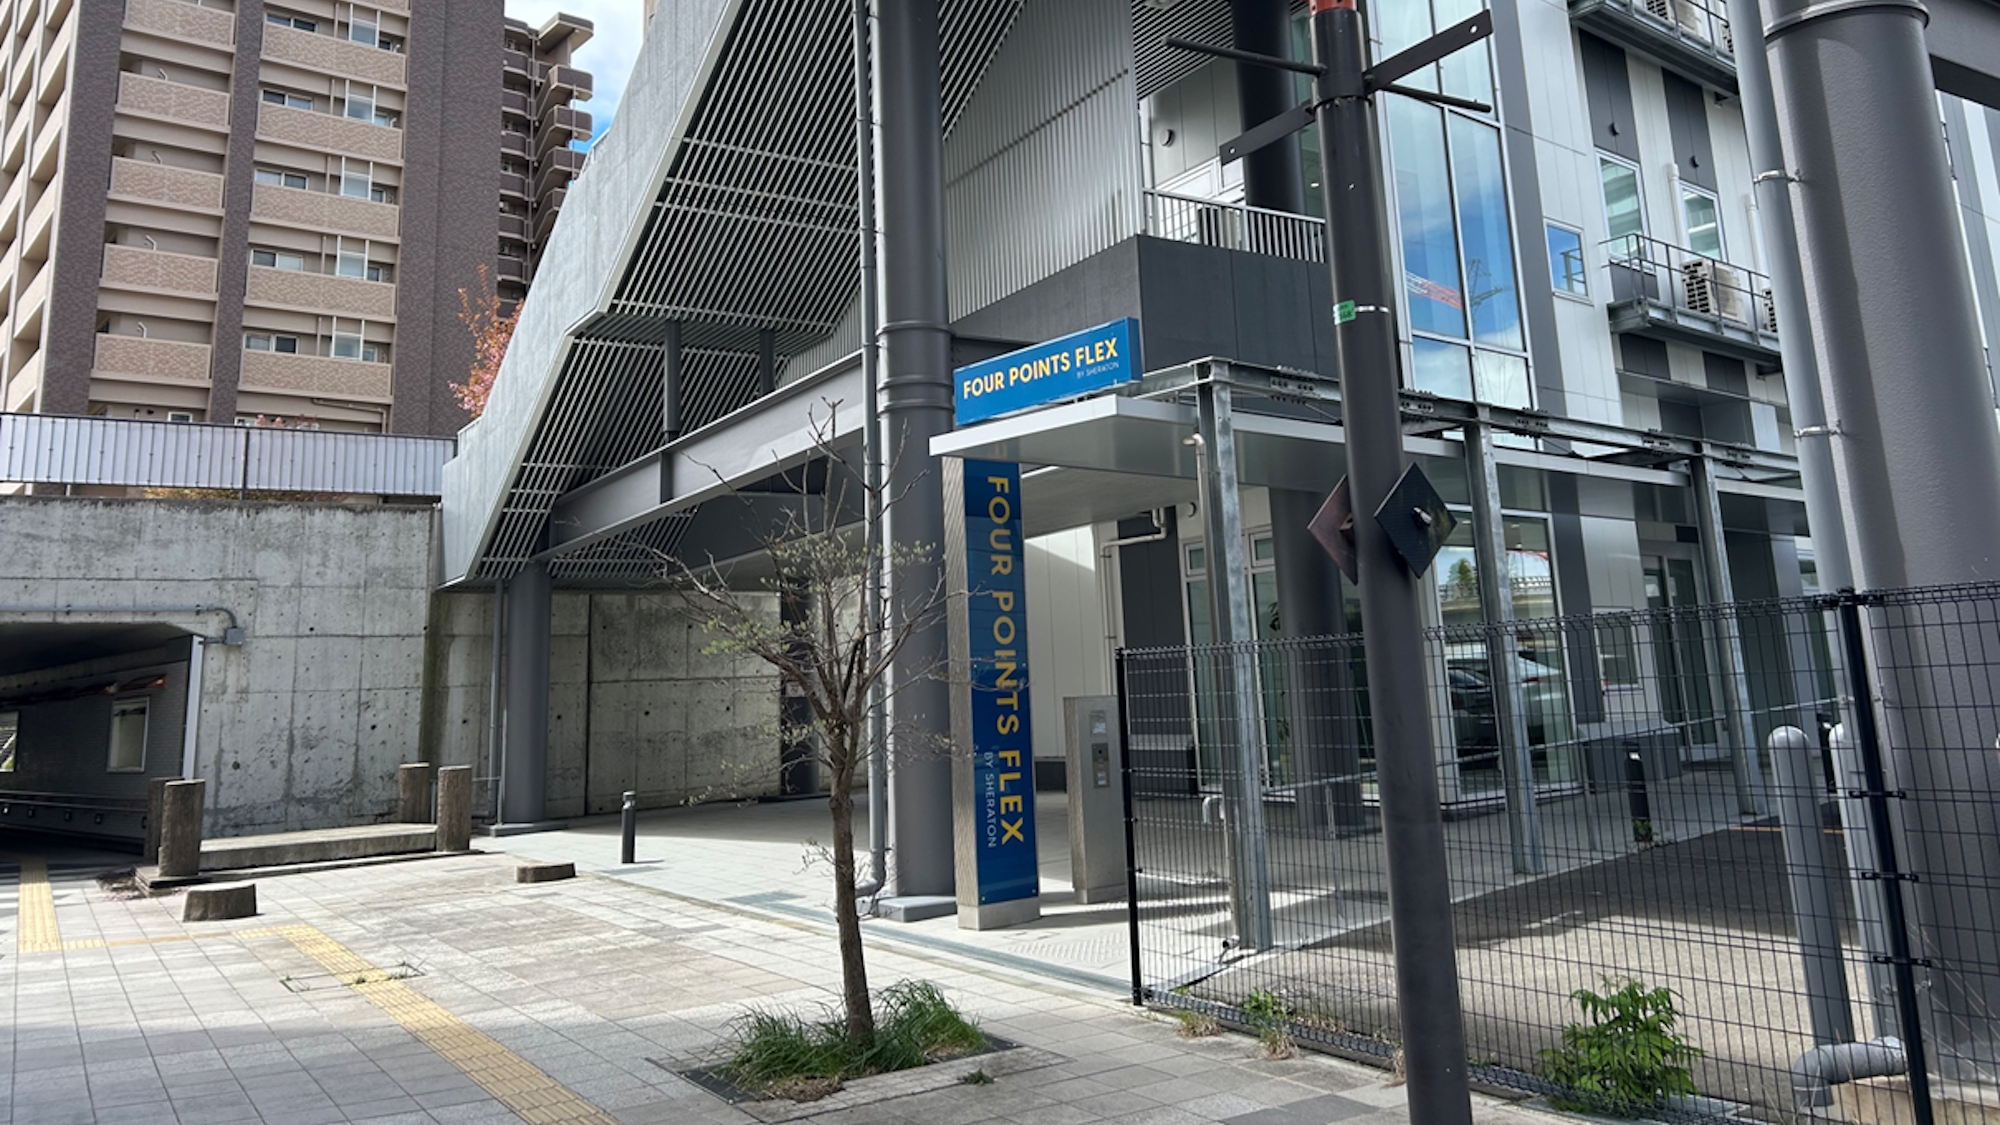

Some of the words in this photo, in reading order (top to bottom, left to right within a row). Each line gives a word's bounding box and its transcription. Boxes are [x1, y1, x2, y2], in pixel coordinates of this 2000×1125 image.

[963, 371, 1005, 400] FOUR
[1009, 352, 1070, 387] POINTS
[1075, 337, 1118, 368] FLEX
[1086, 361, 1119, 377] SHERATON
[987, 476, 1013, 576] FOUR
[992, 591, 1020, 735] POINTS
[984, 752, 994, 768] BY
[998, 750, 1024, 845] FLEX
[985, 773, 997, 848] SHERATON
